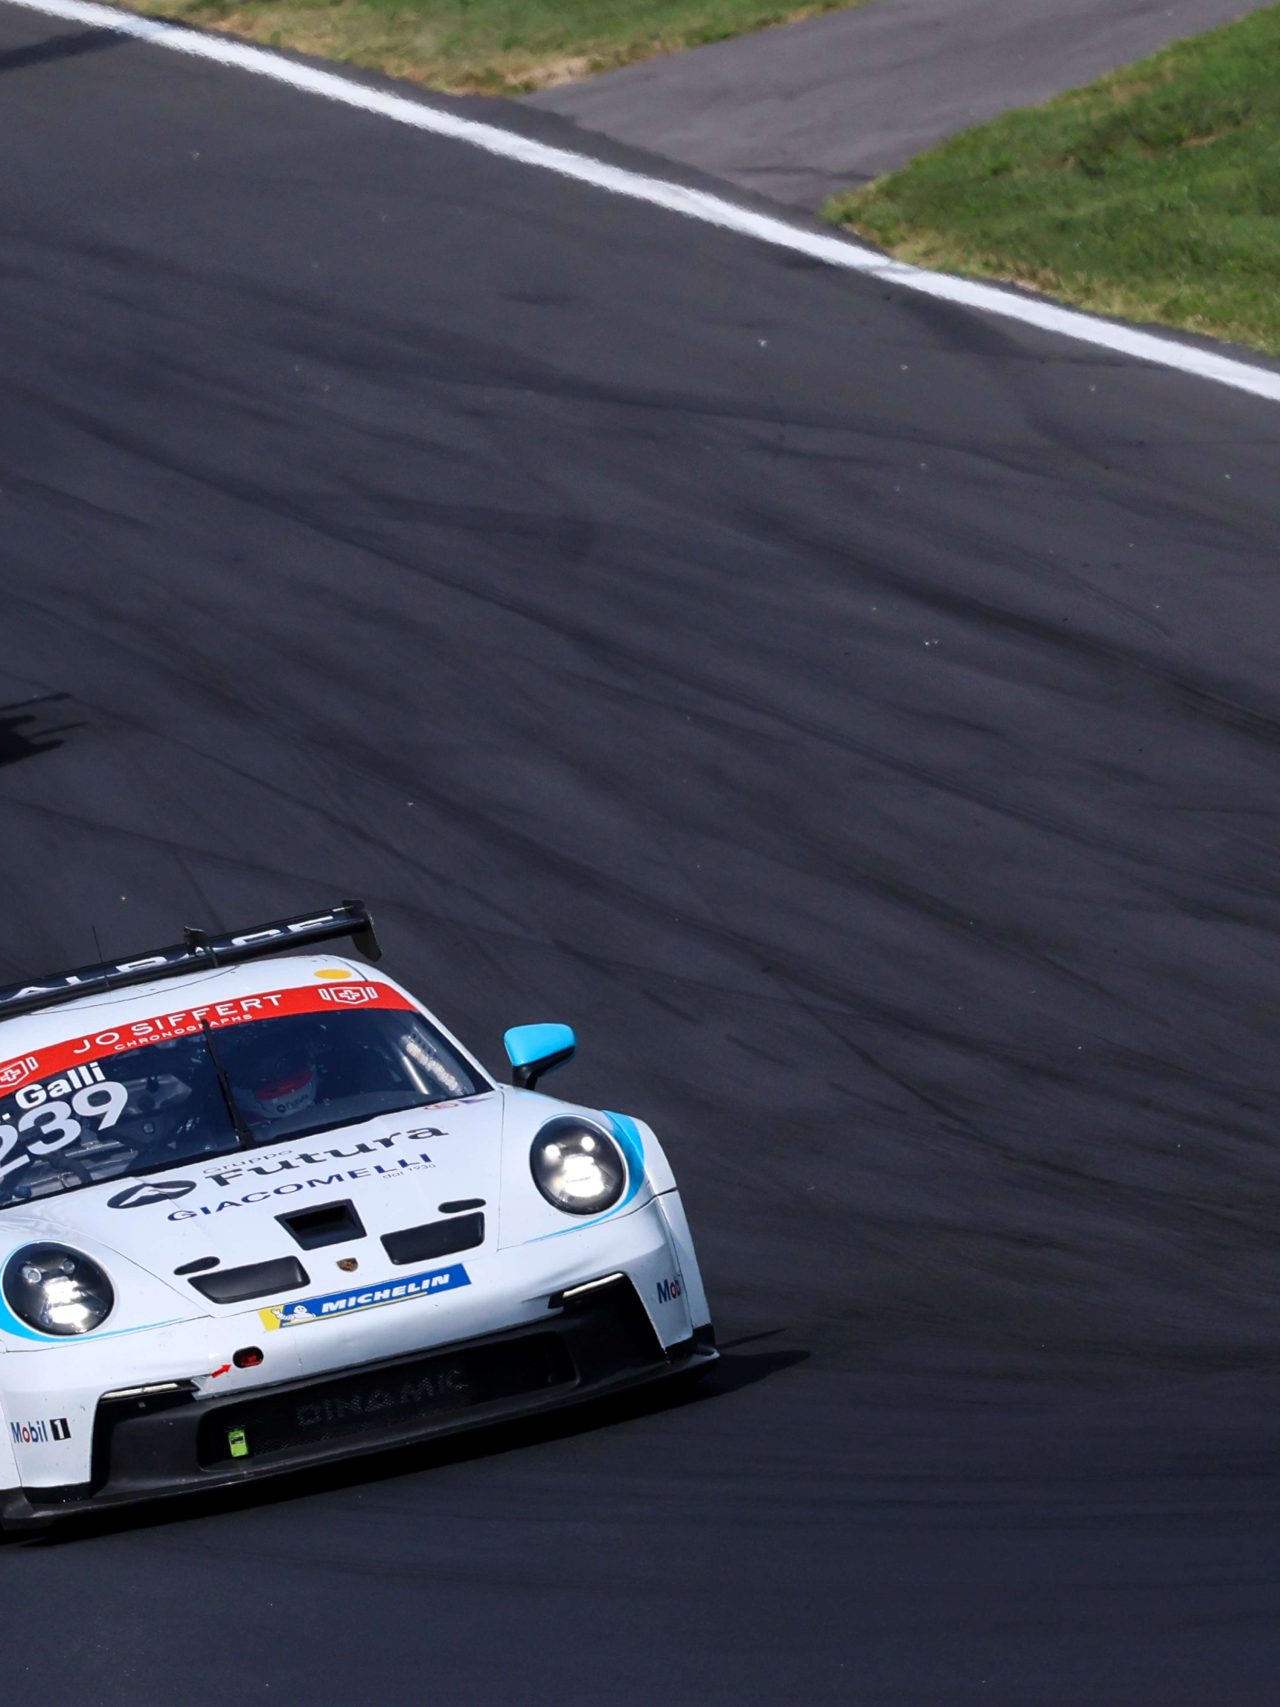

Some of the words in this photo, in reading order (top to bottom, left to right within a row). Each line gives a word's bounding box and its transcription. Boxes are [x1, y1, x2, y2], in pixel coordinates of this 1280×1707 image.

[72, 1031, 120, 1054] JO
[131, 994, 283, 1036] SIFFERT
[15, 1062, 106, 1110] Galli
[203, 1149, 293, 1174] Gruppo
[205, 1127, 449, 1187] Futura
[167, 1153, 433, 1221] GIACOMELLI
[322, 1273, 450, 1313] MICHELIN
[10, 1420, 48, 1443] Mobil
[52, 1418, 69, 1440] 1
